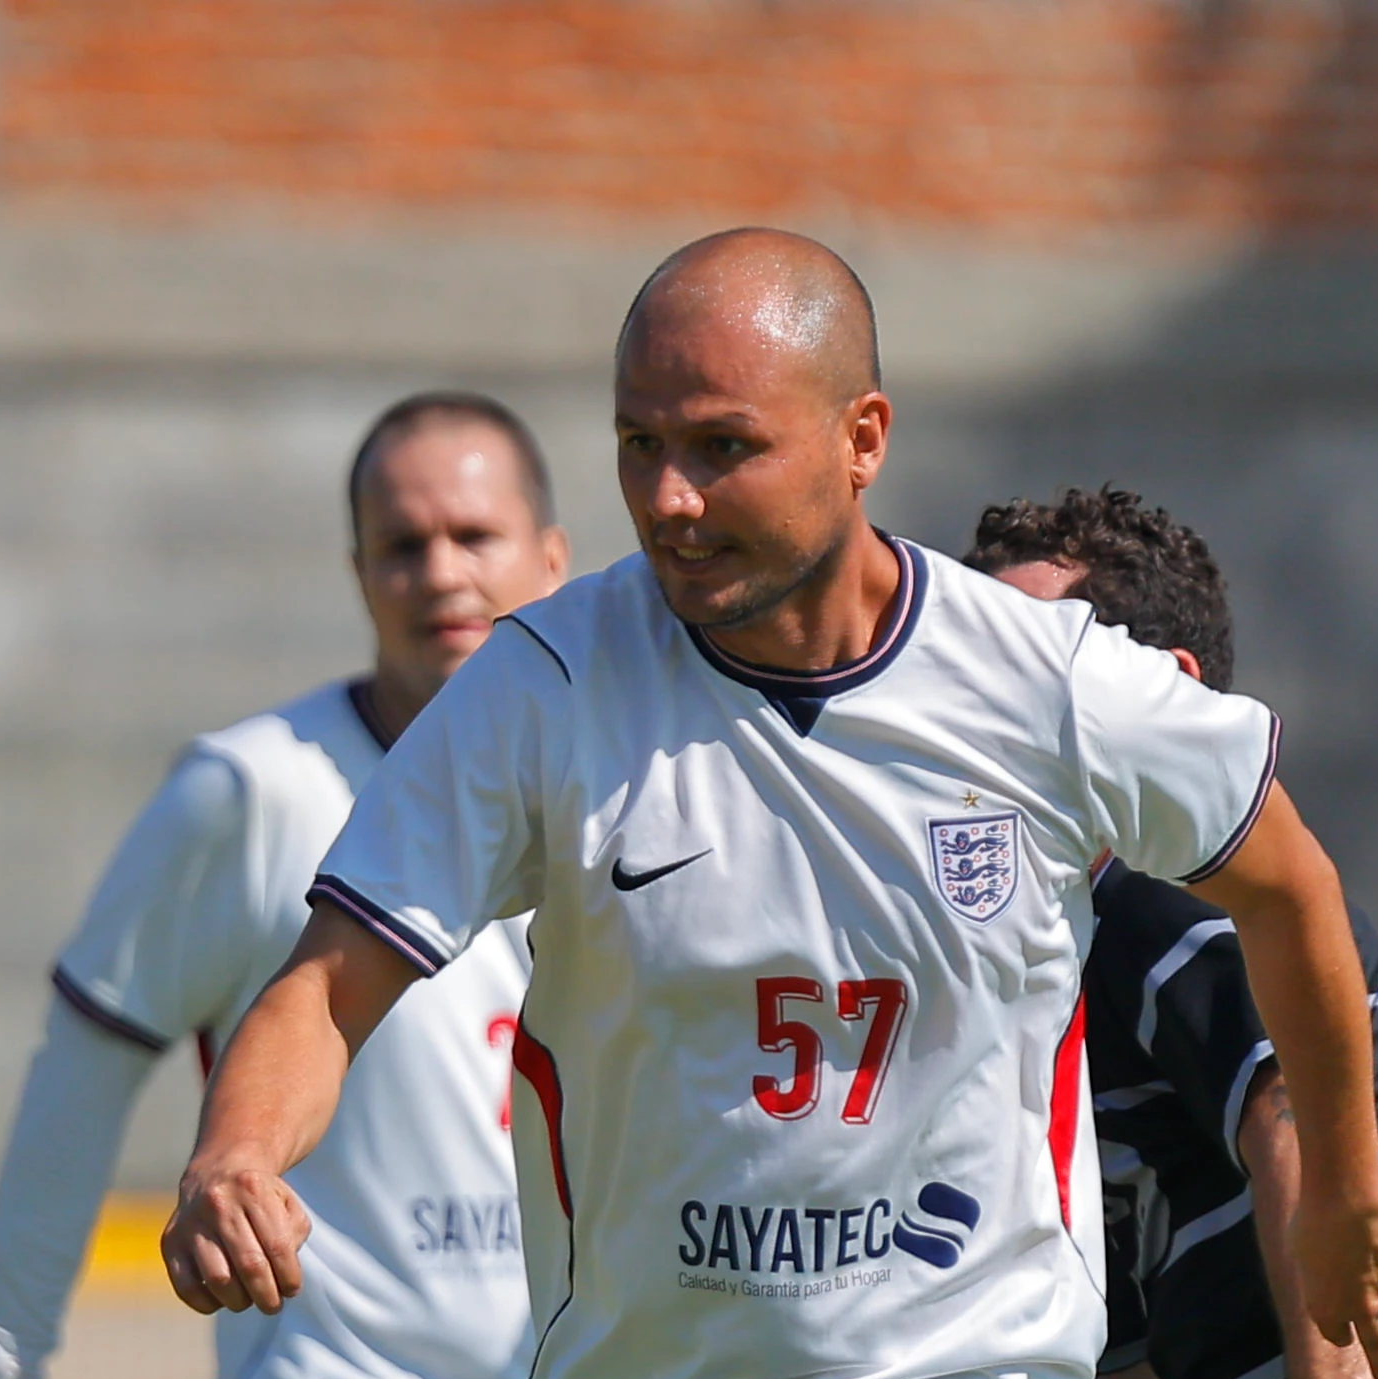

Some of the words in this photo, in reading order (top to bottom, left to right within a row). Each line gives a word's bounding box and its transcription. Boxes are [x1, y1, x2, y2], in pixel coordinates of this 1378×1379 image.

[752, 976, 908, 1125] 57
[678, 1198, 890, 1273] SAYATEC
[678, 1271, 727, 1292] Calidad
[729, 1281, 737, 1295] y
[804, 1279, 832, 1300] para
[835, 1274, 848, 1290] tu
[851, 1268, 891, 1288] Hogar
